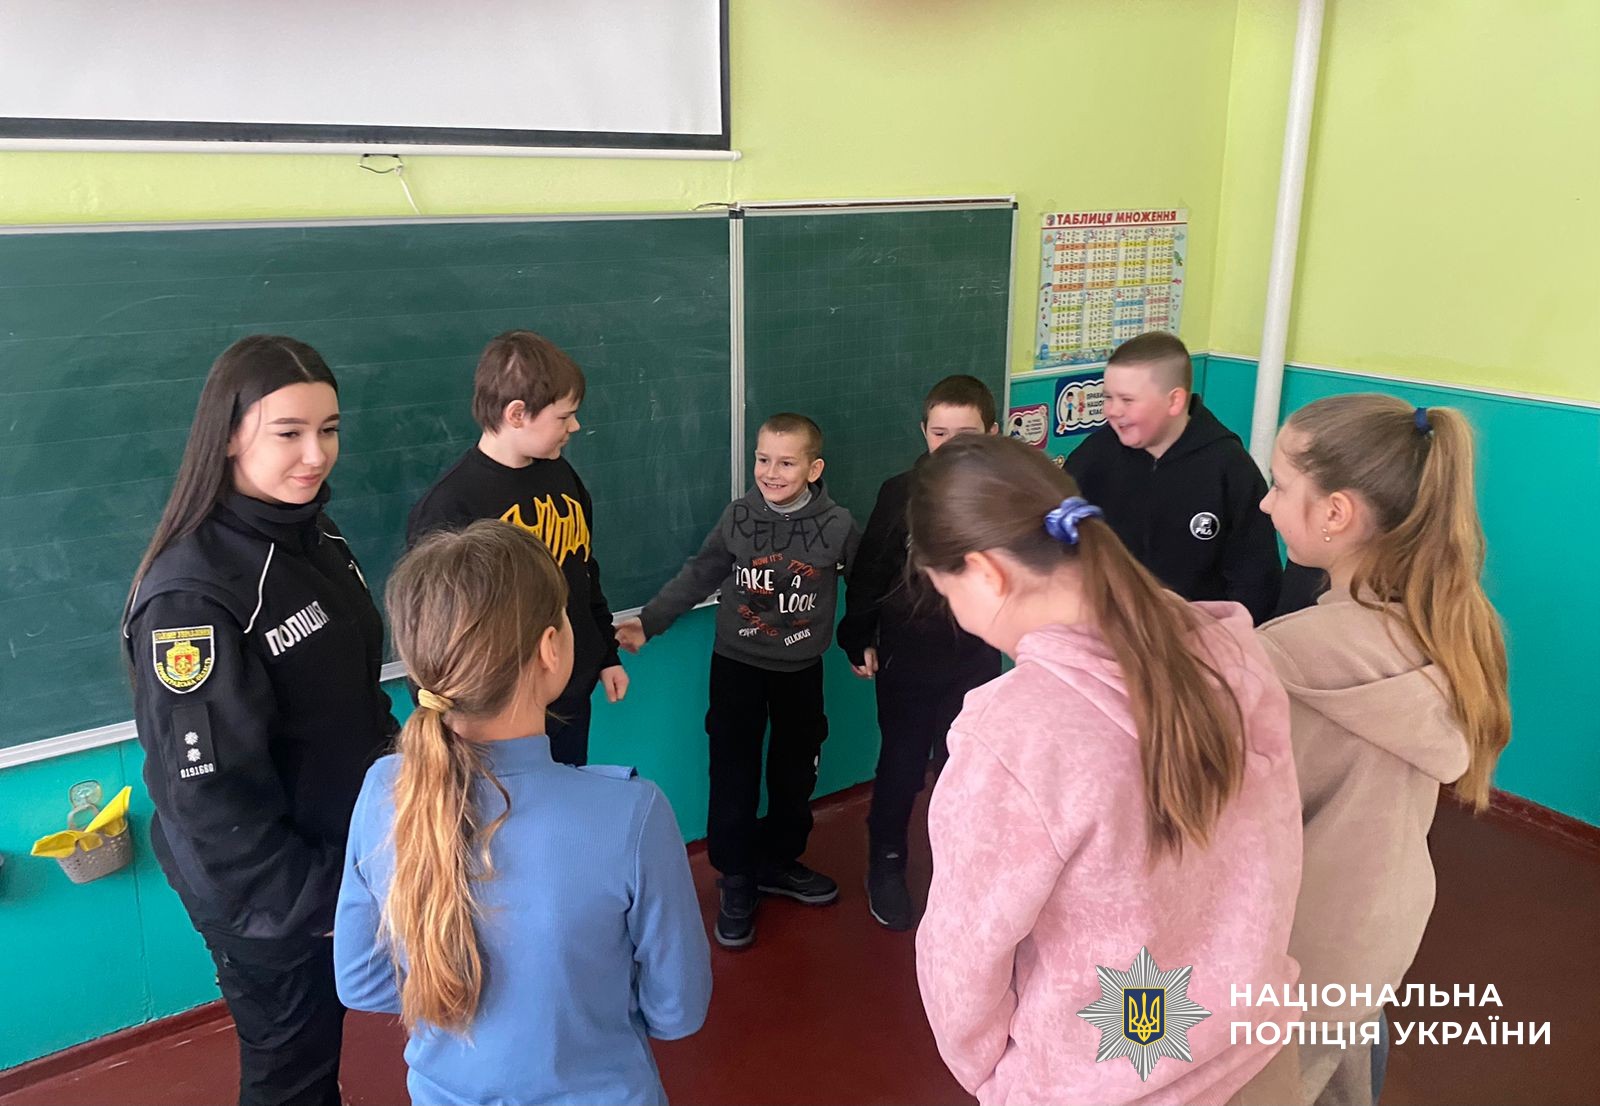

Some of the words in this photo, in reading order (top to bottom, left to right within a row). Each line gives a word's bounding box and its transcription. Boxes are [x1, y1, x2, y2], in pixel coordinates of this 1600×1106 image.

[1057, 213, 1112, 225] ТАБЛИЦЯ
[1115, 211, 1176, 223] МНОЖЕННЯ
[731, 505, 838, 552] RELAX
[791, 574, 801, 589] A
[778, 592, 817, 614] LOOK
[264, 601, 330, 656] ПОЛІЦІЯ
